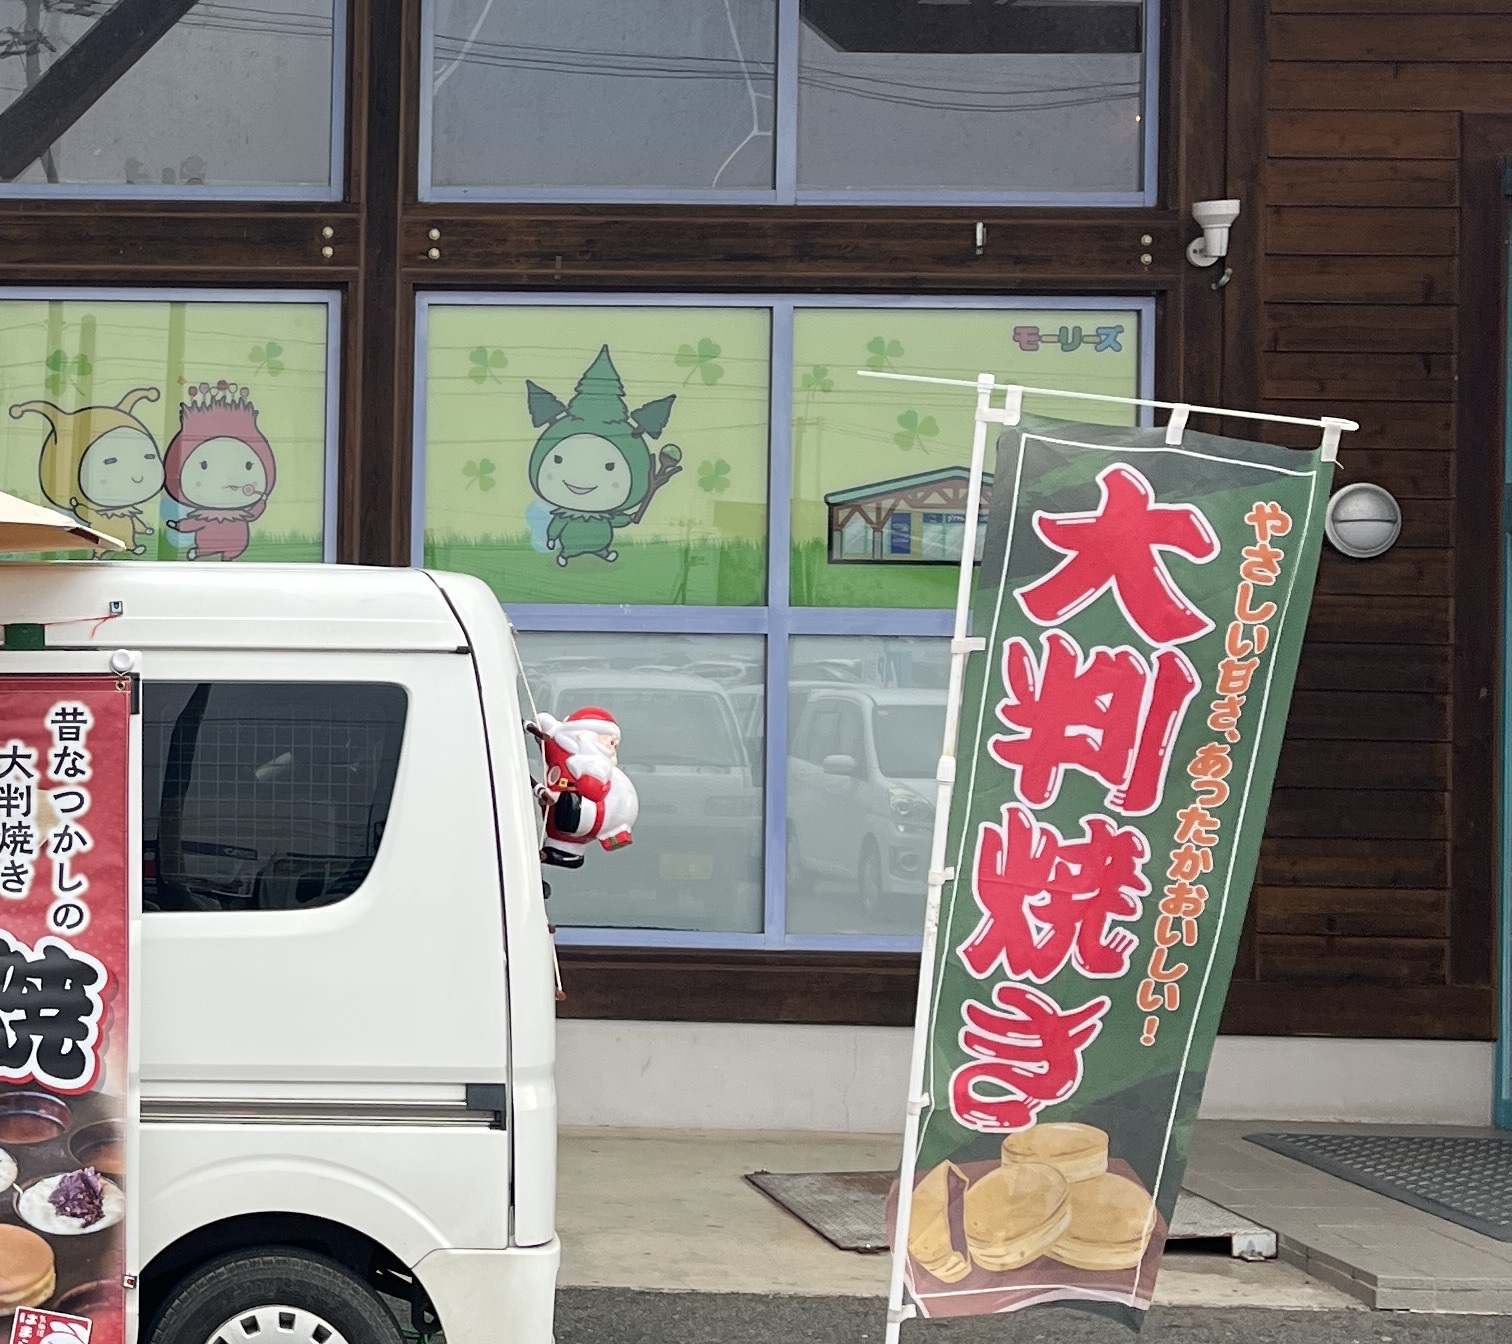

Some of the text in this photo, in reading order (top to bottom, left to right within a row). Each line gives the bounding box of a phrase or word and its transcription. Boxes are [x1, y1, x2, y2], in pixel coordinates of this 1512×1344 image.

[1013, 325, 1124, 352] モーリーズ
[47, 705, 91, 932] 昔なつかしの
[949, 462, 1221, 1133] 大判焼き
